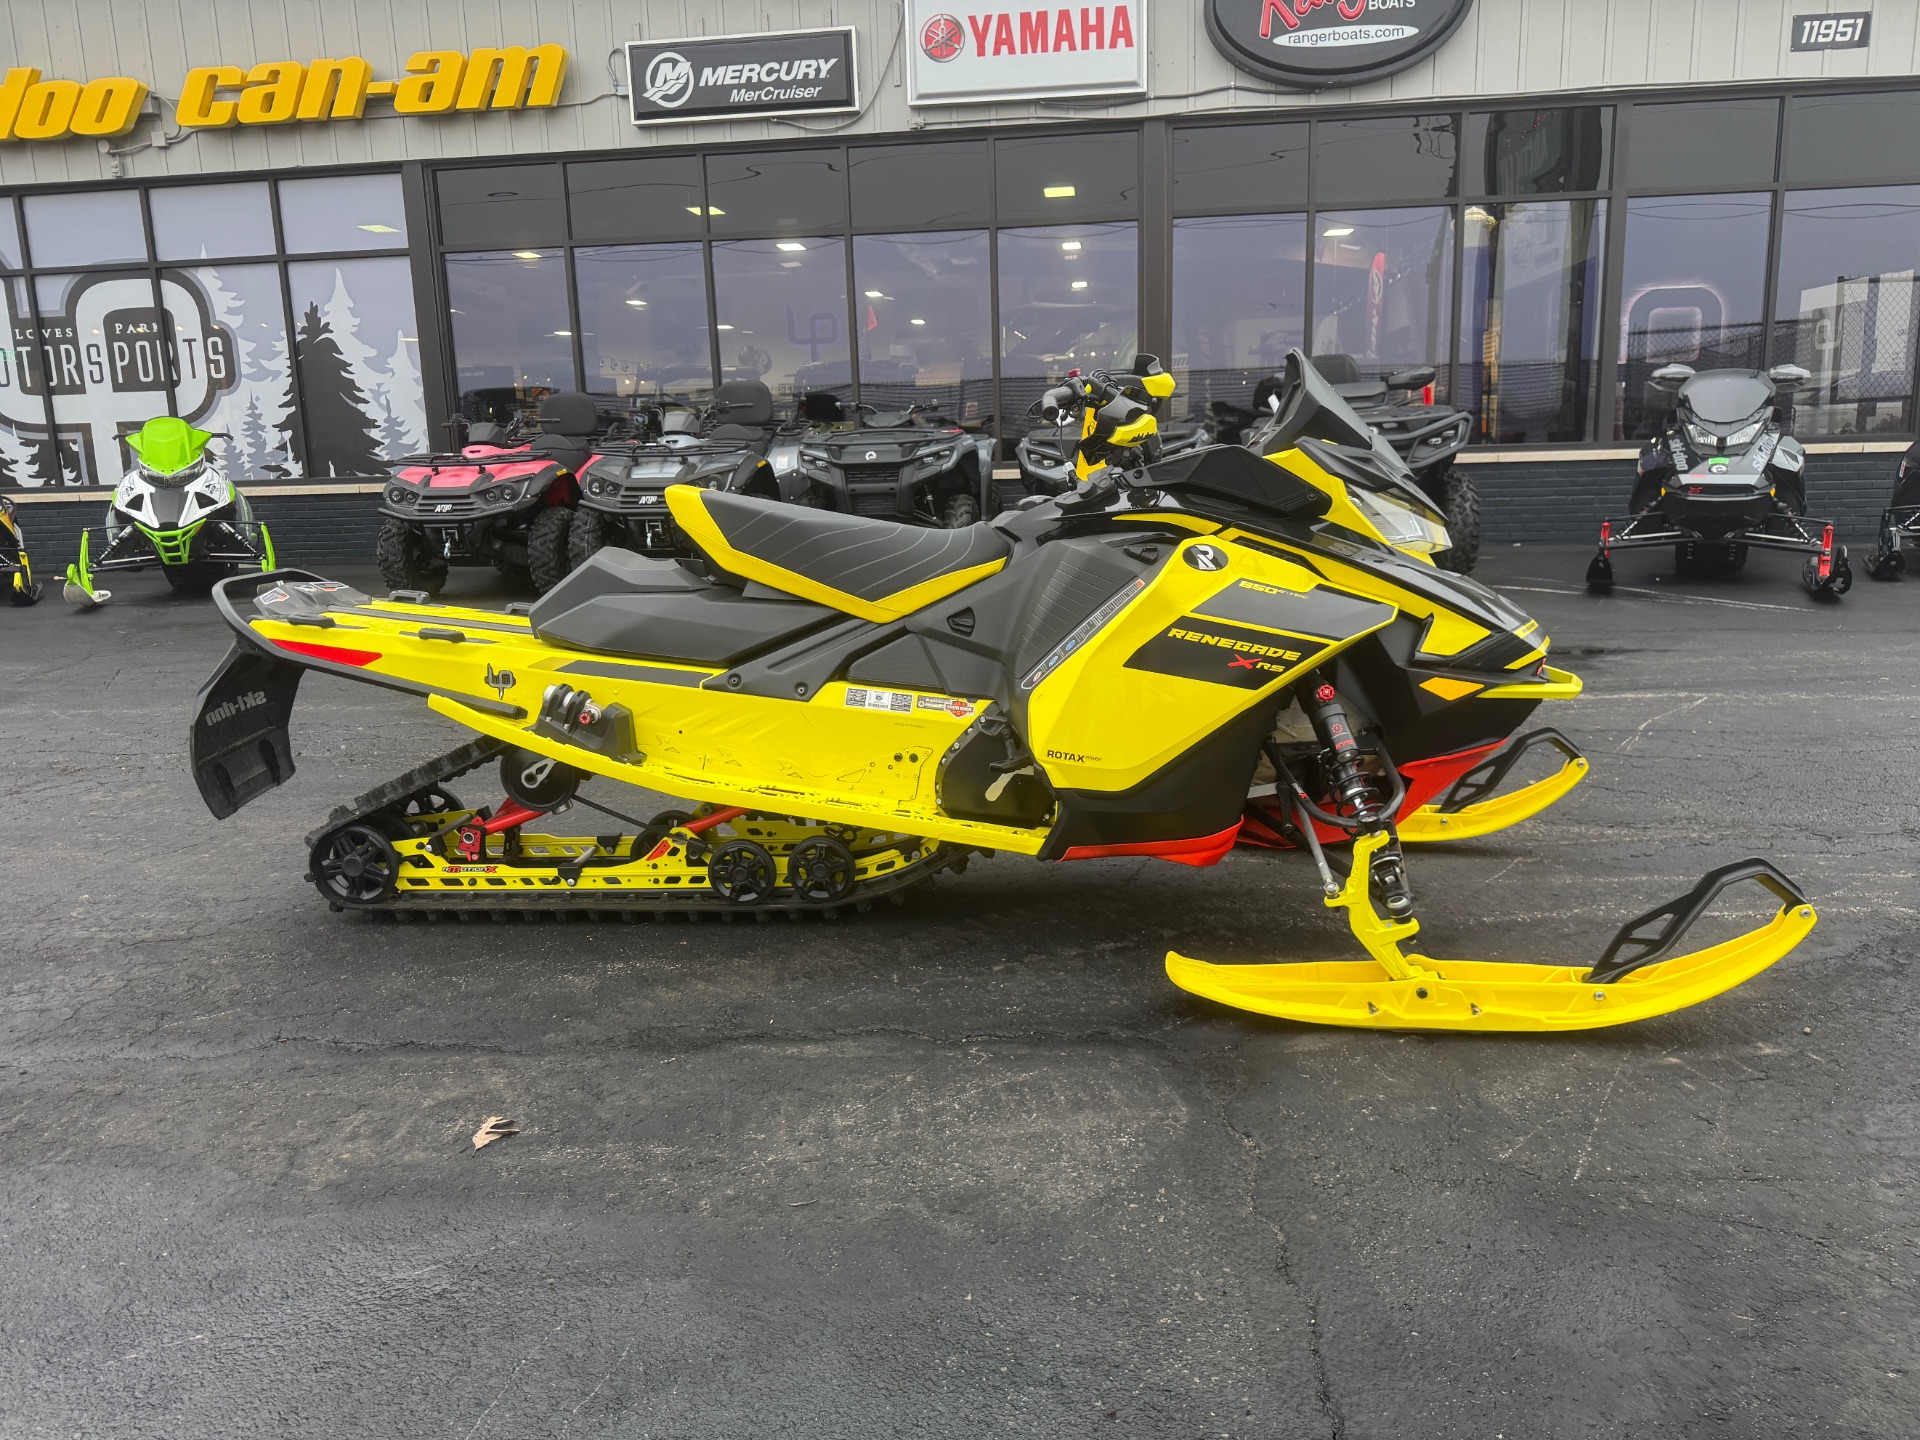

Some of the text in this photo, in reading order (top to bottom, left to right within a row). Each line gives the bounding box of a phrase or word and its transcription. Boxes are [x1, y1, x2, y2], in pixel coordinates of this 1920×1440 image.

[968, 5, 1134, 57] YAMAHA
[1288, 27, 1404, 46] rangerboats.com
[1801, 18, 1864, 43] 11951
[699, 58, 839, 87] MERCURY
[176, 43, 571, 128] can-am
[729, 85, 823, 103] MerCruiser
[1239, 580, 1279, 595] 850
[1167, 627, 1302, 661] RENEGADE
[1046, 749, 1085, 763] ROTAX
